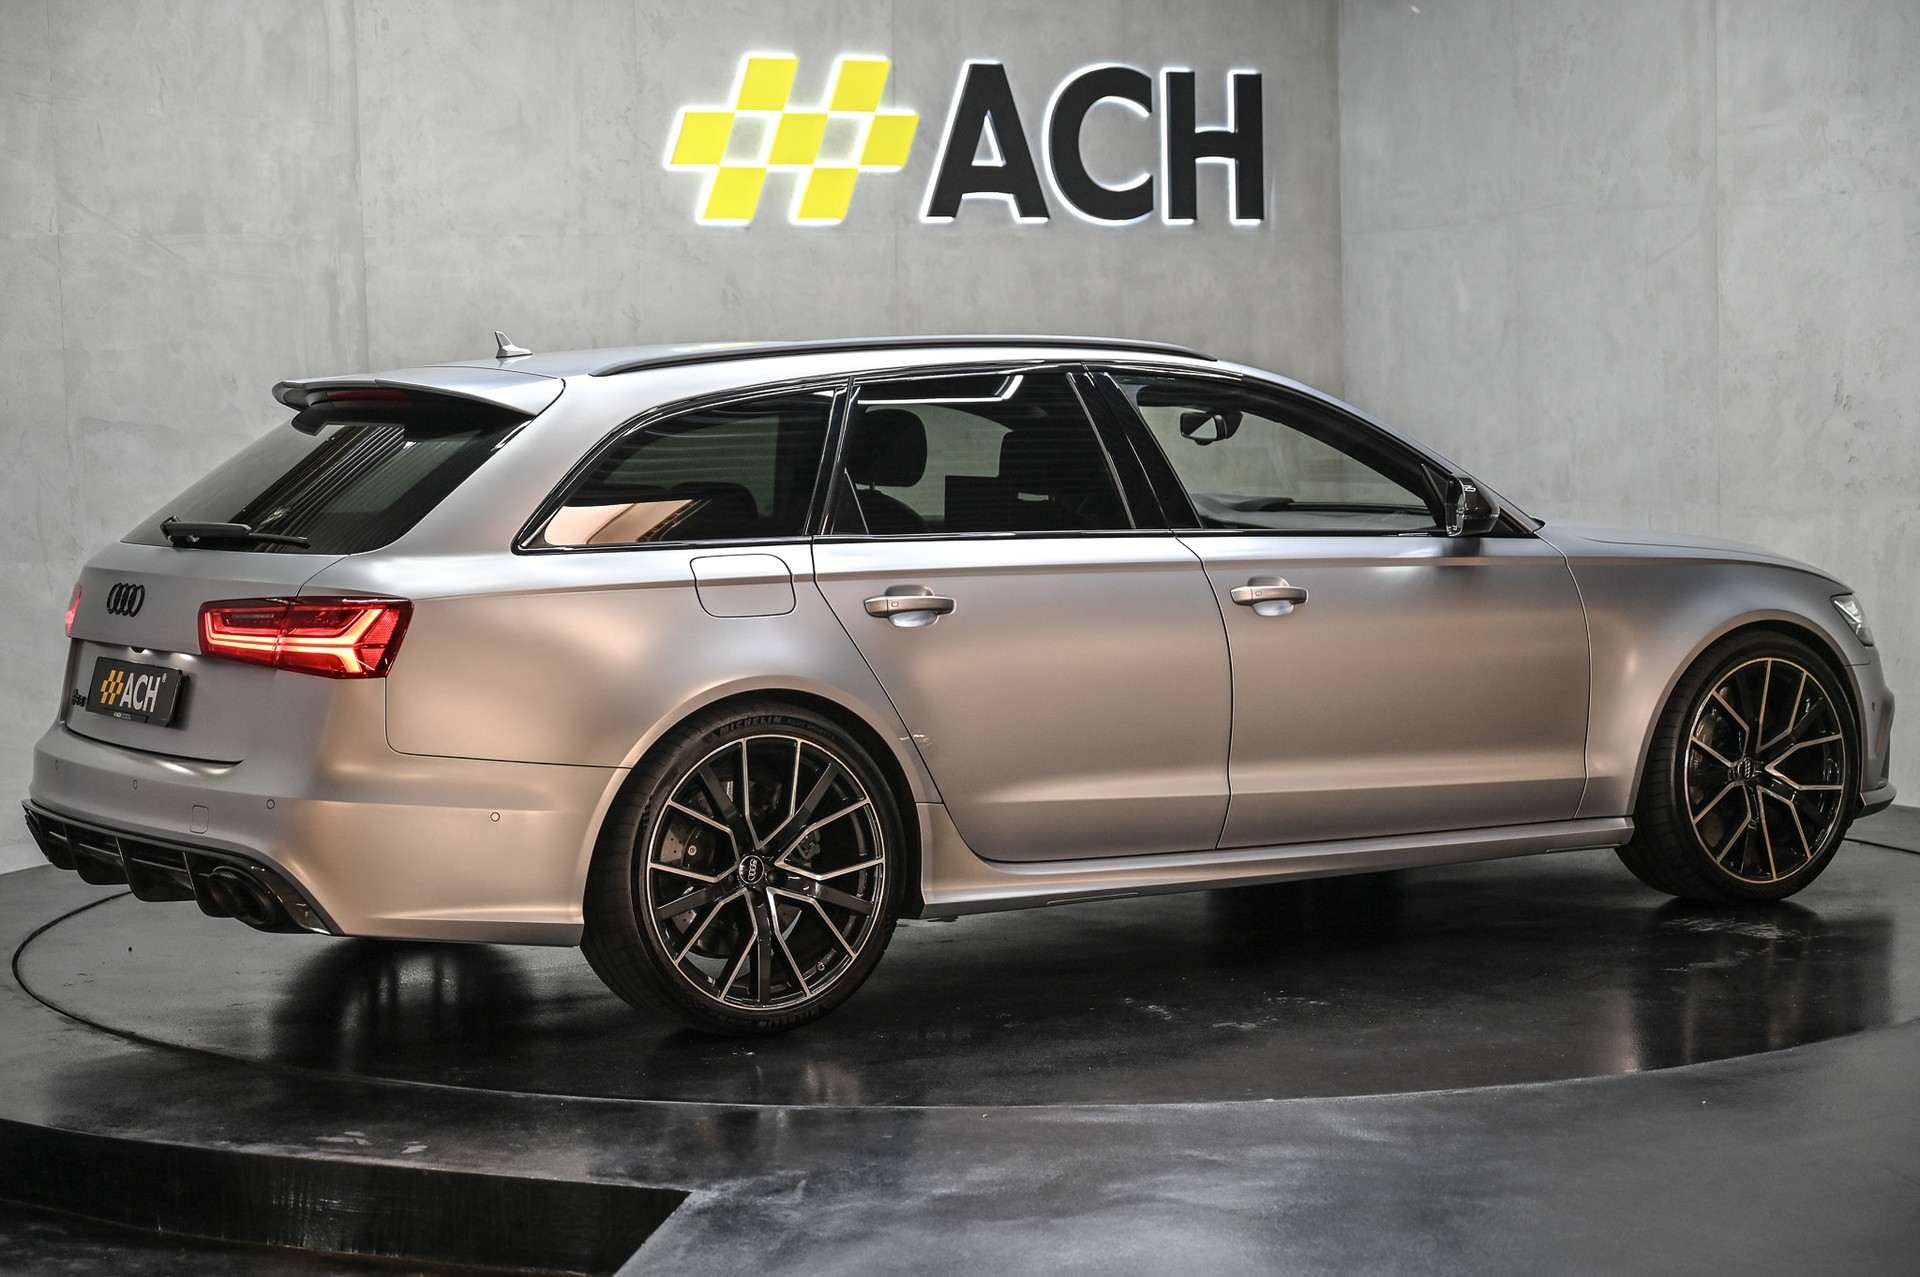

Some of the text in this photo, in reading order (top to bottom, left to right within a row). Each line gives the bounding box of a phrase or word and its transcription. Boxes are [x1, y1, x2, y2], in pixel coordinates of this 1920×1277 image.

[922, 62, 1265, 226] ACH
[119, 672, 161, 713] ACH
[719, 715, 782, 735] MICHELIN
